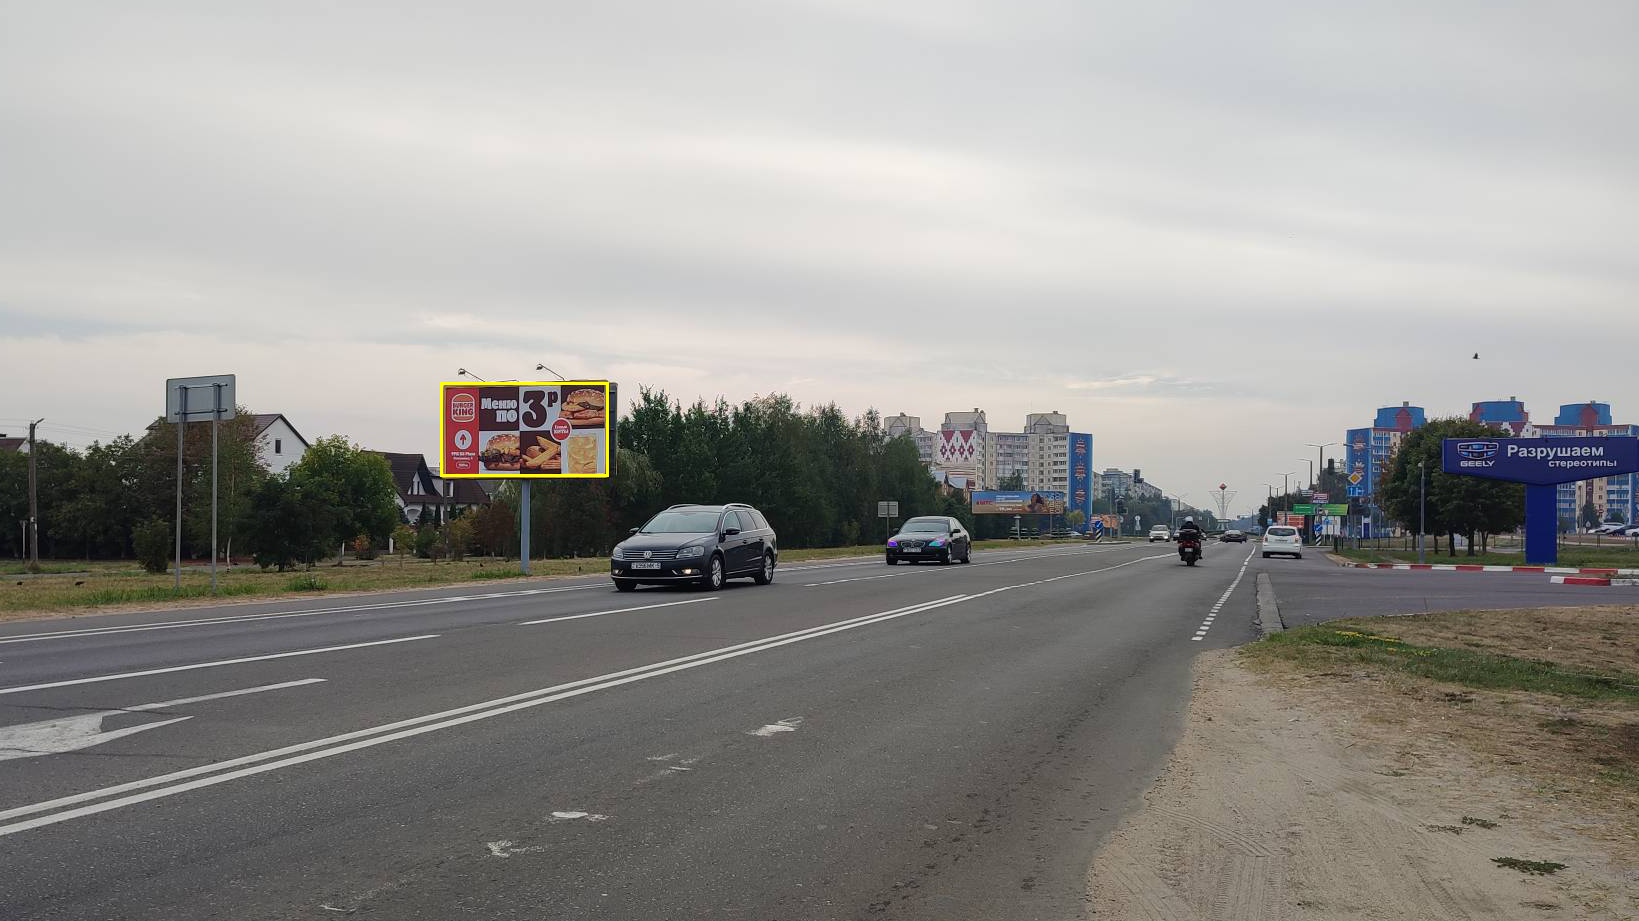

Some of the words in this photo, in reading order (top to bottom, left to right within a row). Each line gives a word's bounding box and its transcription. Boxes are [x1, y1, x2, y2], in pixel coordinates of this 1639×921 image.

[481, 398, 518, 410] Меню
[453, 408, 473, 416] KING
[496, 409, 518, 422] по
[1507, 444, 1604, 460] Разрушаем
[1548, 459, 1617, 468] стереотипы
